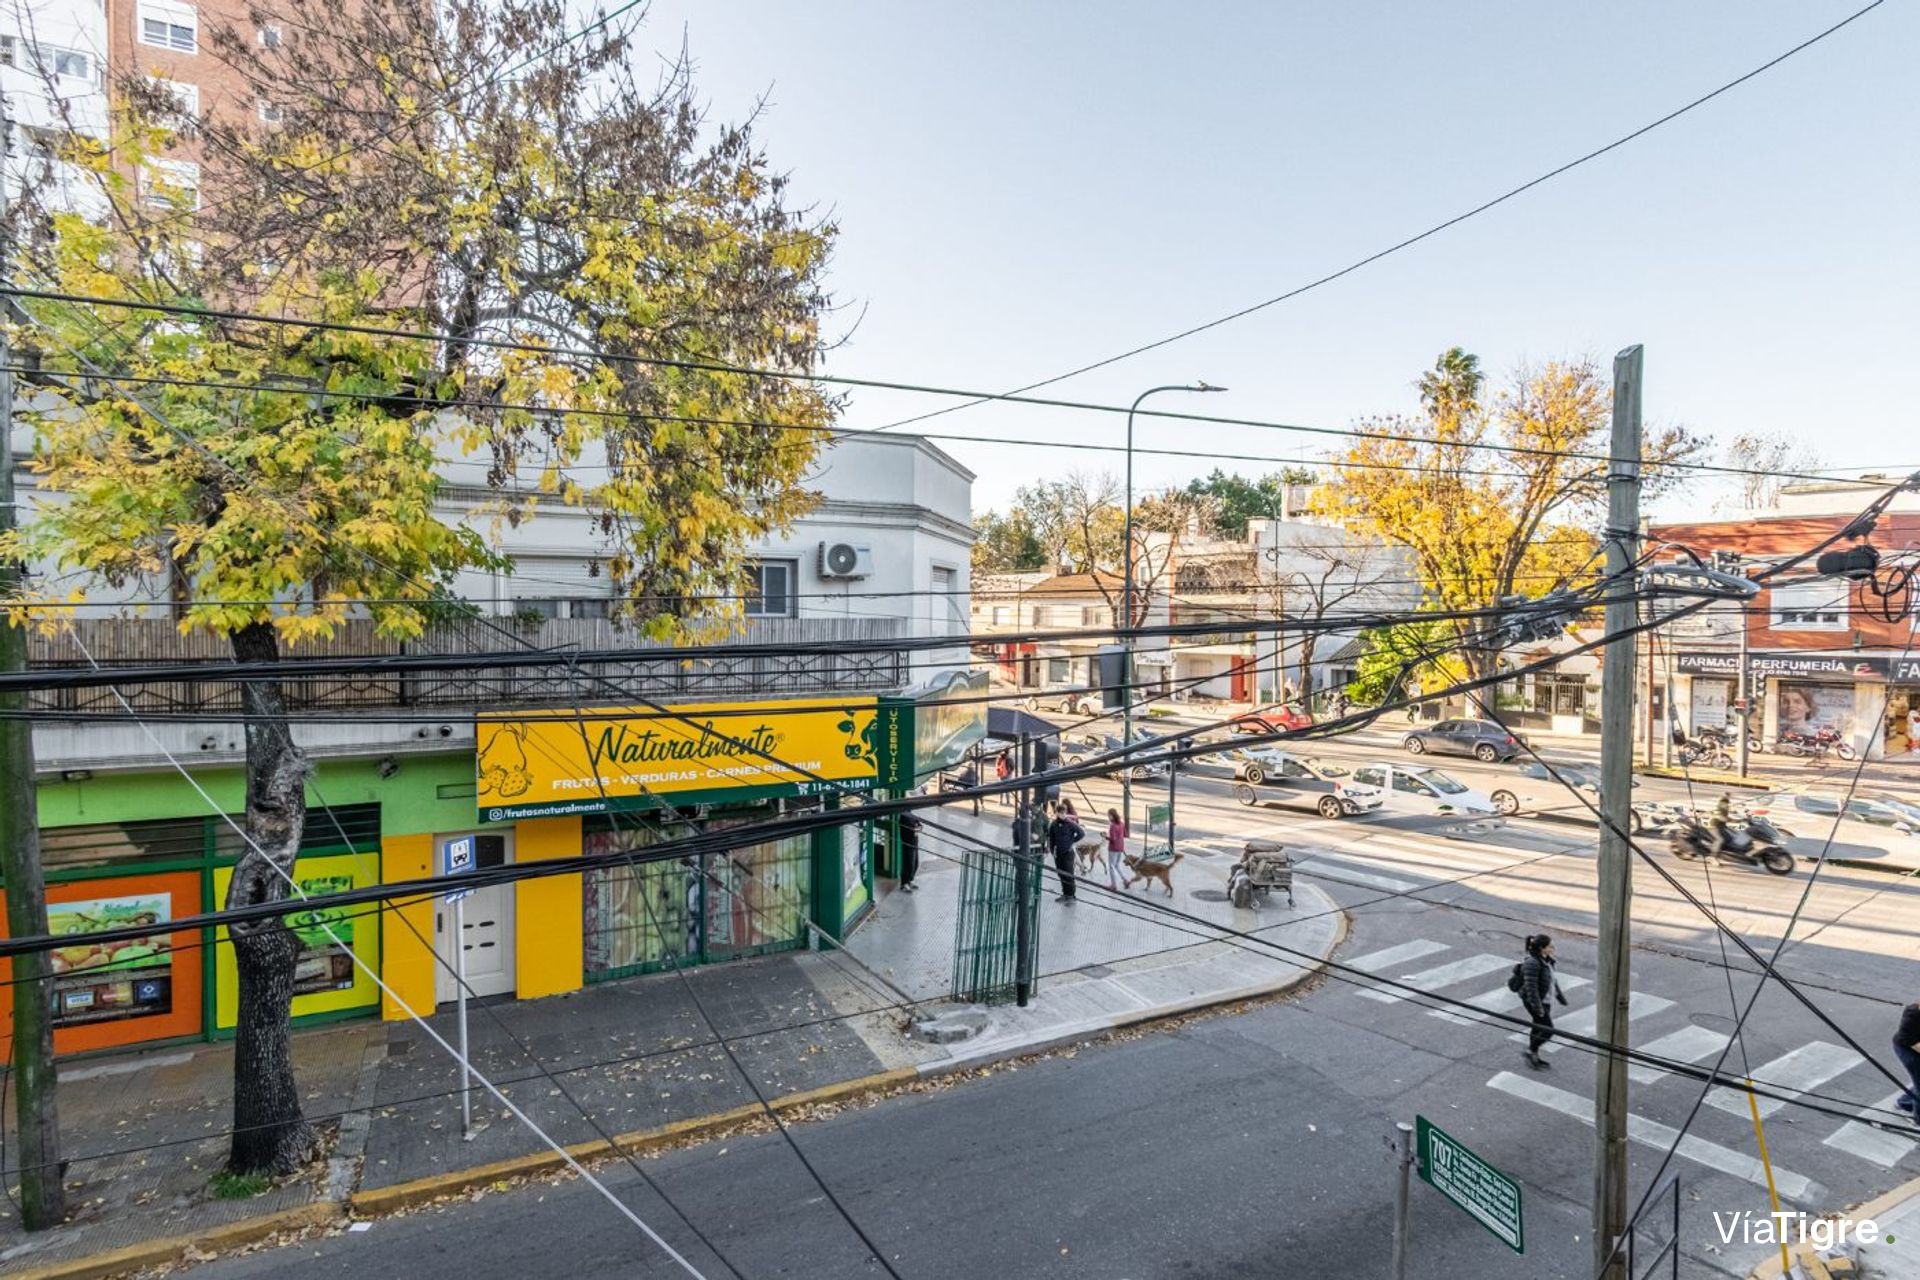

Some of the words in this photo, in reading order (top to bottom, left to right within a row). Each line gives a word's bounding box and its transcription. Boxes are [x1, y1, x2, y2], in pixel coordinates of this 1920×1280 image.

[1681, 656, 1741, 668] FARMACI
[1752, 658, 1847, 672] PERFUMERÍA
[593, 720, 778, 767] Naturalmente
[552, 776, 610, 790] FRUTAS
[620, 769, 698, 785] VERDURAS
[706, 765, 761, 779] CARNES
[1432, 1135, 1452, 1169] 707
